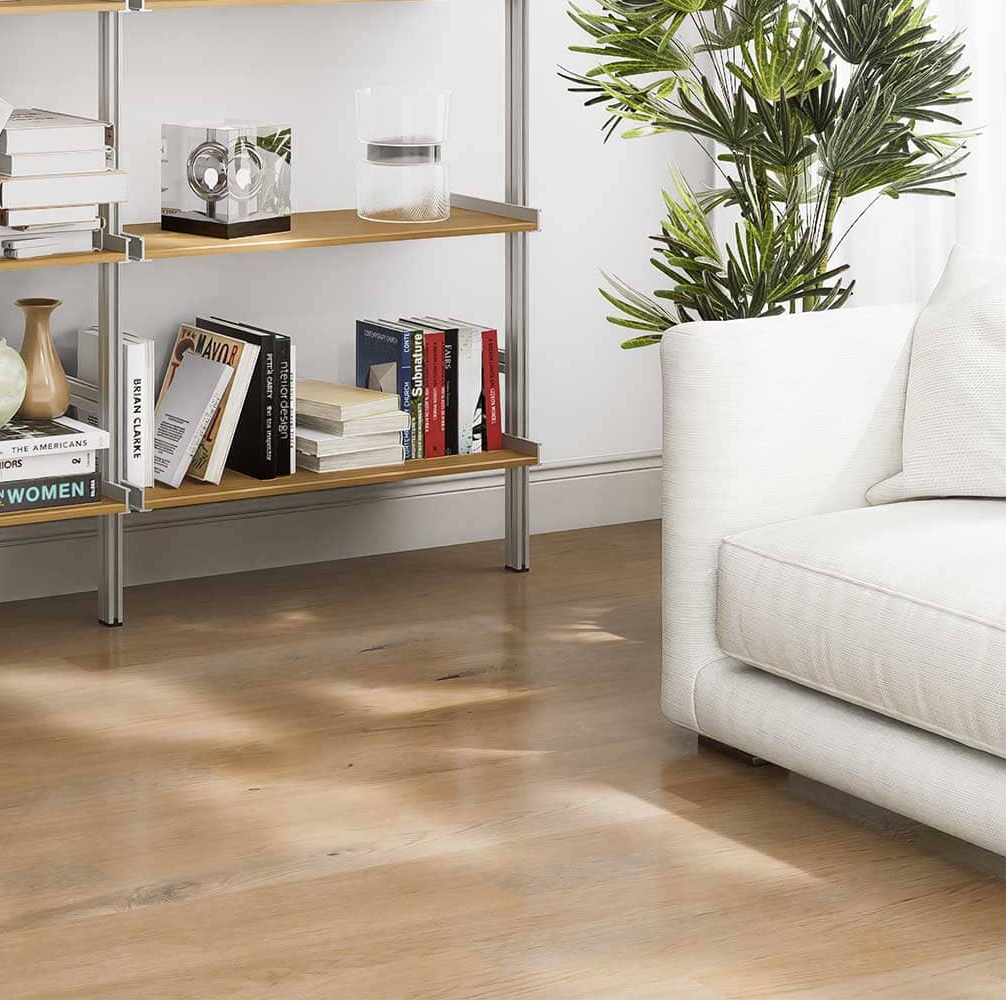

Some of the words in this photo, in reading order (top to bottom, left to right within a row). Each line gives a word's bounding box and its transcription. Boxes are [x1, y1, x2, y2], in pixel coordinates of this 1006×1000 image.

[195, 333, 238, 366] MAYOR
[412, 333, 423, 397] Subnature
[133, 378, 142, 414] BRIAN
[278, 400, 288, 440] design
[11, 446, 29, 454] THE
[32, 440, 88, 451] AMERICANS
[133, 417, 142, 459] CLARKE
[72, 457, 81, 465] 2
[7, 480, 85, 504] WOMEN
